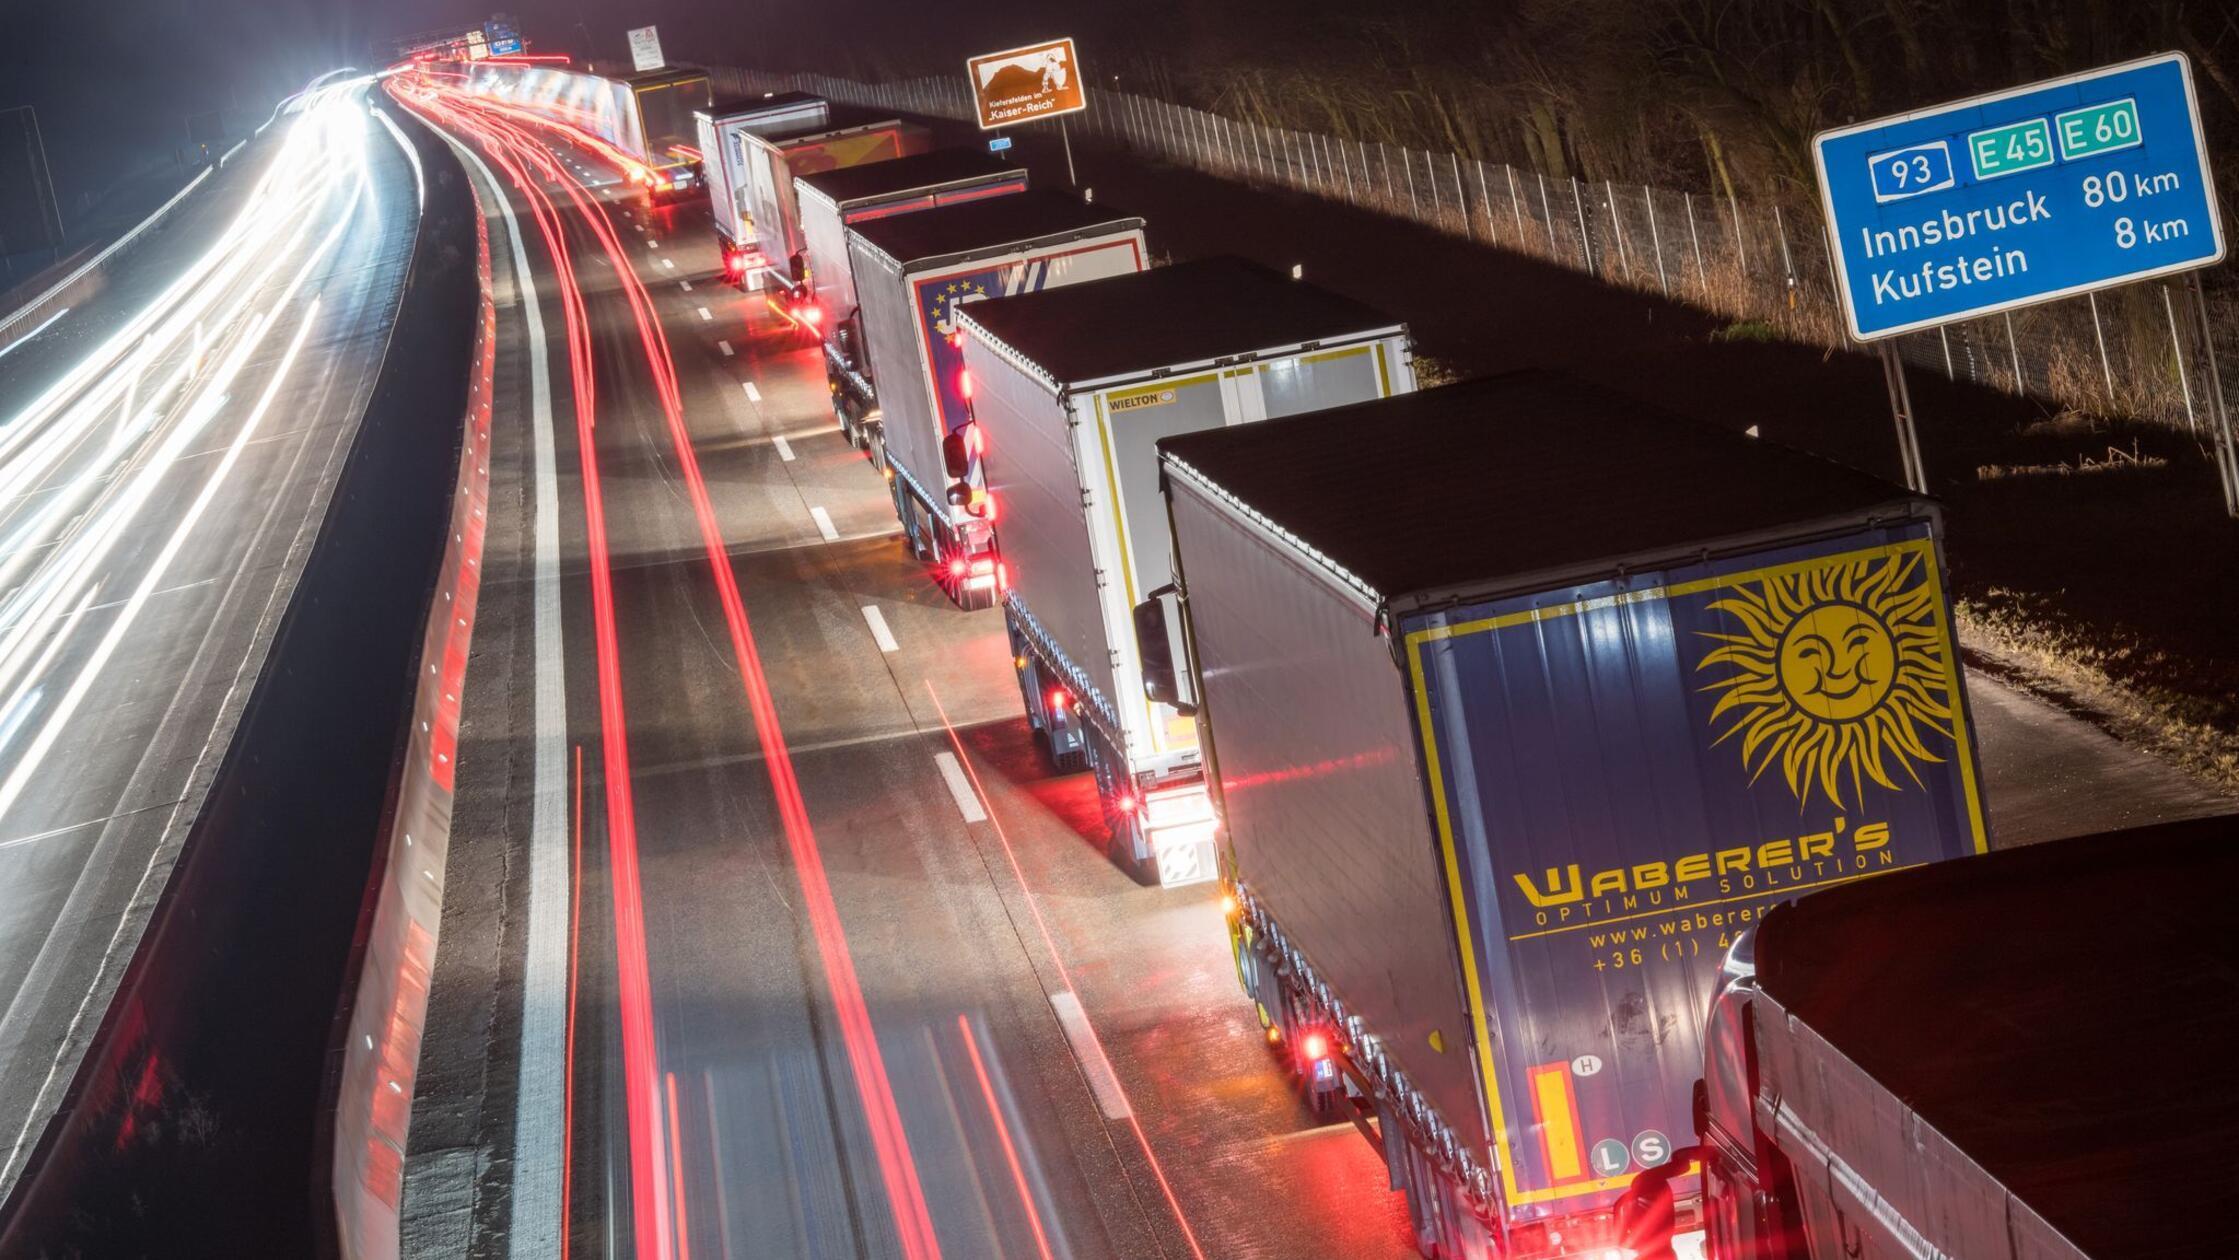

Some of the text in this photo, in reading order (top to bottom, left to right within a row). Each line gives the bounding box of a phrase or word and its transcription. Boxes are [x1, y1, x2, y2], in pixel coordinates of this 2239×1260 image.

[1977, 128, 2045, 169] E 45
[2065, 109, 2133, 151] E 60
[1891, 155, 1931, 189] 93
[1862, 170, 2180, 259] Innsbruck 80 km
[1871, 217, 2189, 305] Kufstein 8 km
[1109, 393, 1159, 411] WIELTON
[1512, 816, 1891, 908] WABERER'S
[1536, 850, 1894, 926] OPTIMUM SOLUTION
[1594, 948, 1643, 972] +36
[1661, 937, 1699, 962] (1)
[1580, 1058, 1594, 1073] H
[1601, 1137, 1665, 1171] L S
